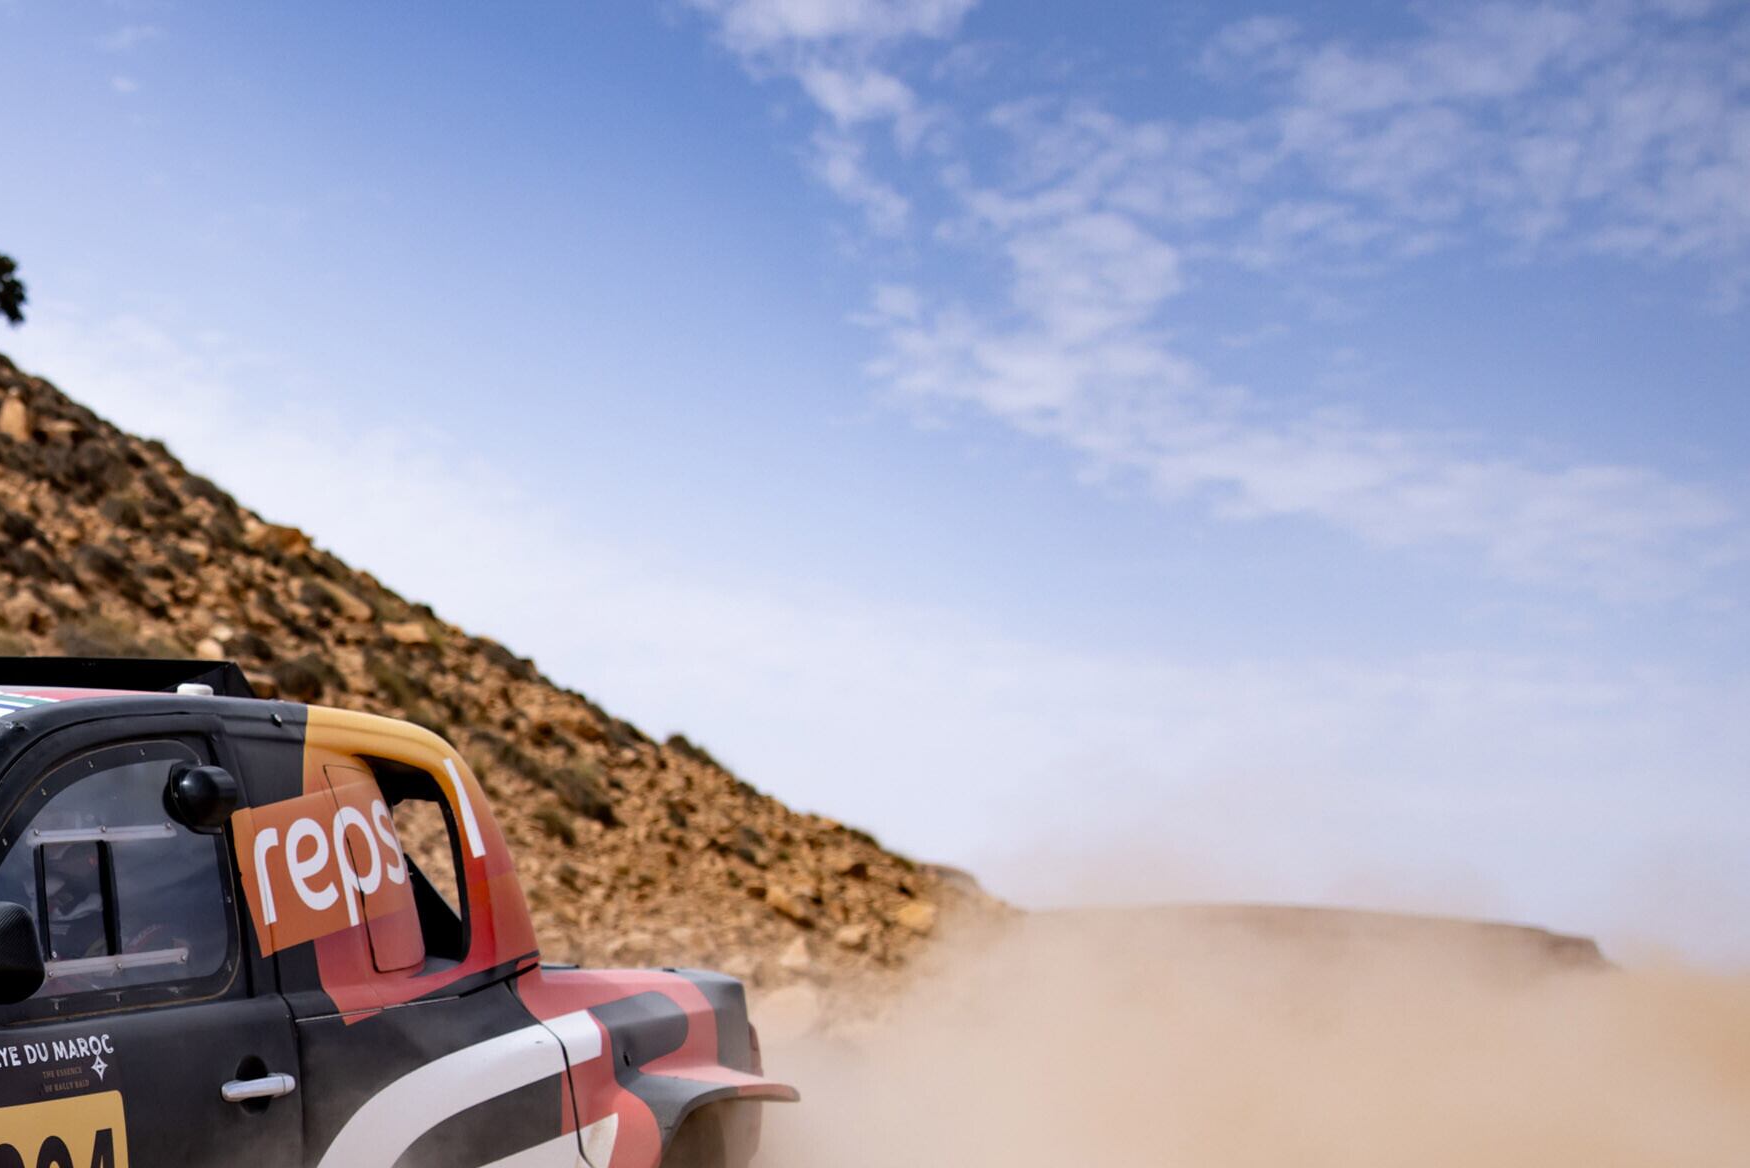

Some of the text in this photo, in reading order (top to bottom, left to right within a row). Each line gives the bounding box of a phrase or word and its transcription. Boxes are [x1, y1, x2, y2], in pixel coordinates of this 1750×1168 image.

[253, 757, 486, 926] repsl
[23, 1043, 49, 1065] DU
[51, 1034, 114, 1061] MAROC
